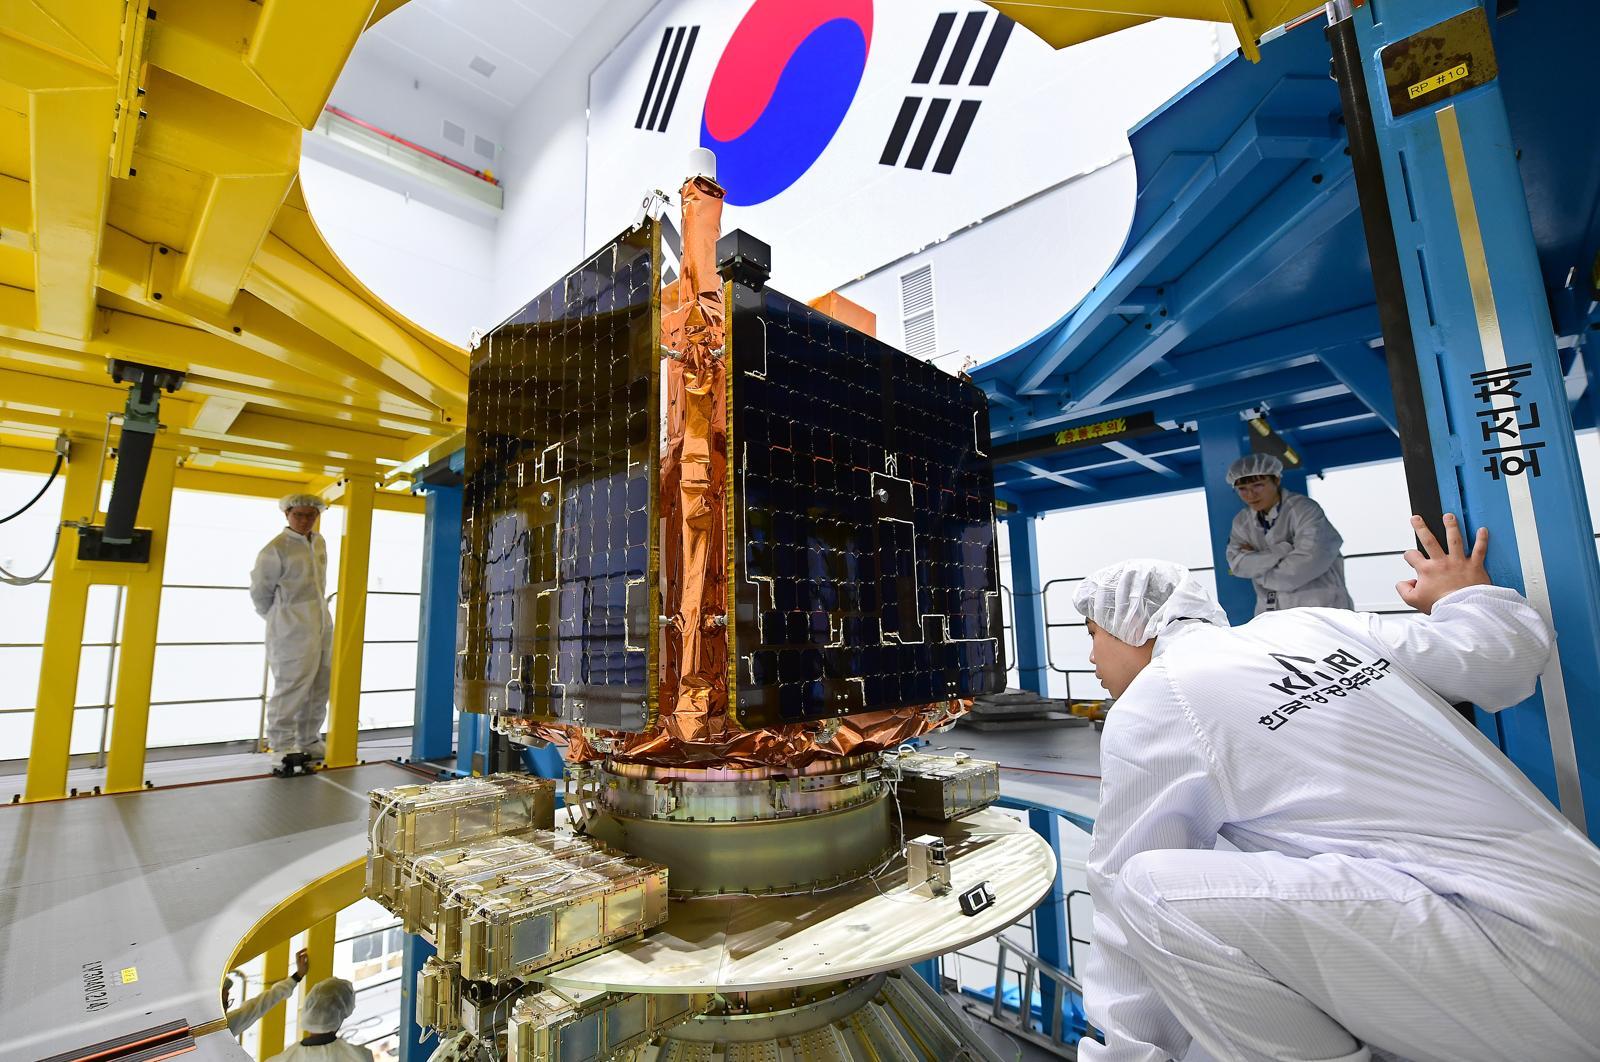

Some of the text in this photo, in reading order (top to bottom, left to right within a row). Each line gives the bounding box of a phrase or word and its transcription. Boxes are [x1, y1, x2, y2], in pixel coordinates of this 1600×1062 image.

[1410, 66, 1465, 95] RP #10
[1470, 363, 1546, 480] 회전체
